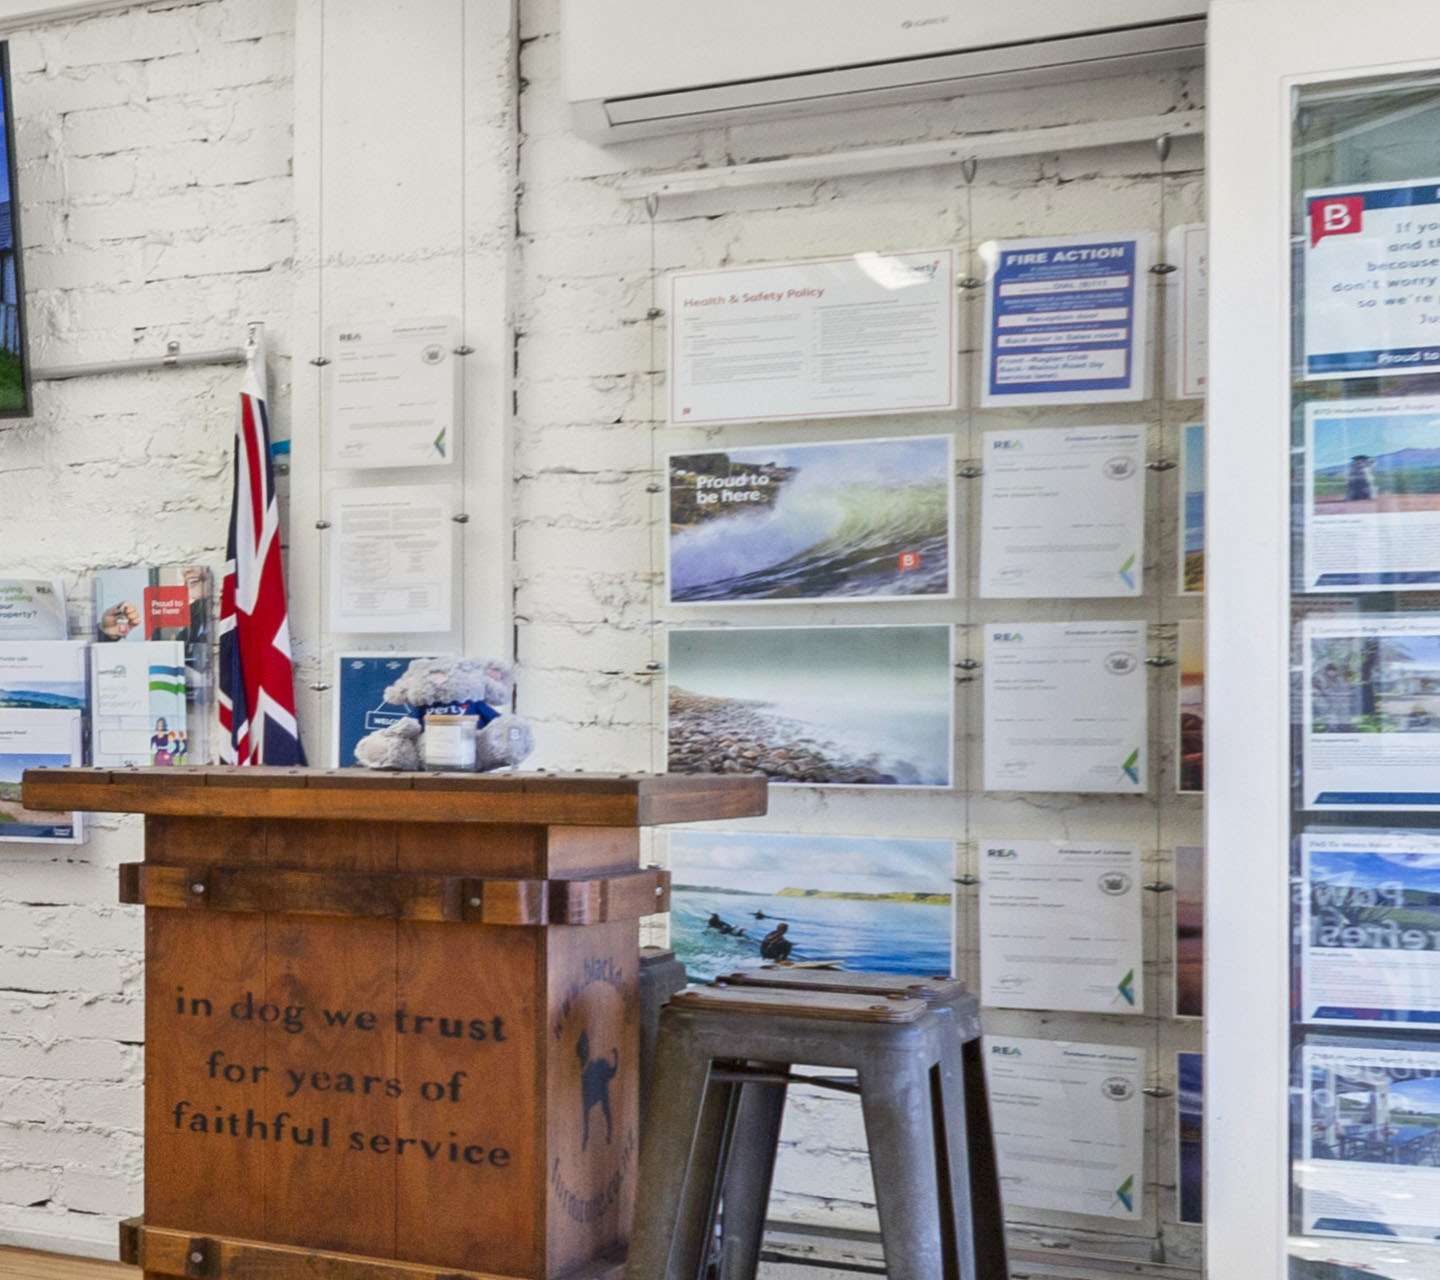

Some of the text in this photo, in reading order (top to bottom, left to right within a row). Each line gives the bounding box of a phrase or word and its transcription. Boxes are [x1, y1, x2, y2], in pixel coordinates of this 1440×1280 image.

[1323, 204, 1351, 231] B
[1418, 222, 1440, 234] yo
[1388, 241, 1422, 252] and
[1006, 246, 1125, 266] FIRE ACTION
[1367, 258, 1439, 272] because
[1332, 276, 1438, 293] don't worry
[683, 286, 826, 308] Health & Safety Policy
[1358, 295, 1432, 308] so we're
[1378, 351, 1440, 365] Proud to
[696, 473, 770, 490] Proud to
[696, 489, 761, 504] be here
[151, 600, 175, 608] Proud
[151, 607, 180, 615] be here
[993, 633, 1023, 641] REA
[987, 849, 1018, 858] REA
[176, 986, 507, 1042] in dog we trust
[992, 1046, 1022, 1056] REA
[207, 1051, 467, 1103] for years of
[172, 1102, 511, 1168] faithful service
